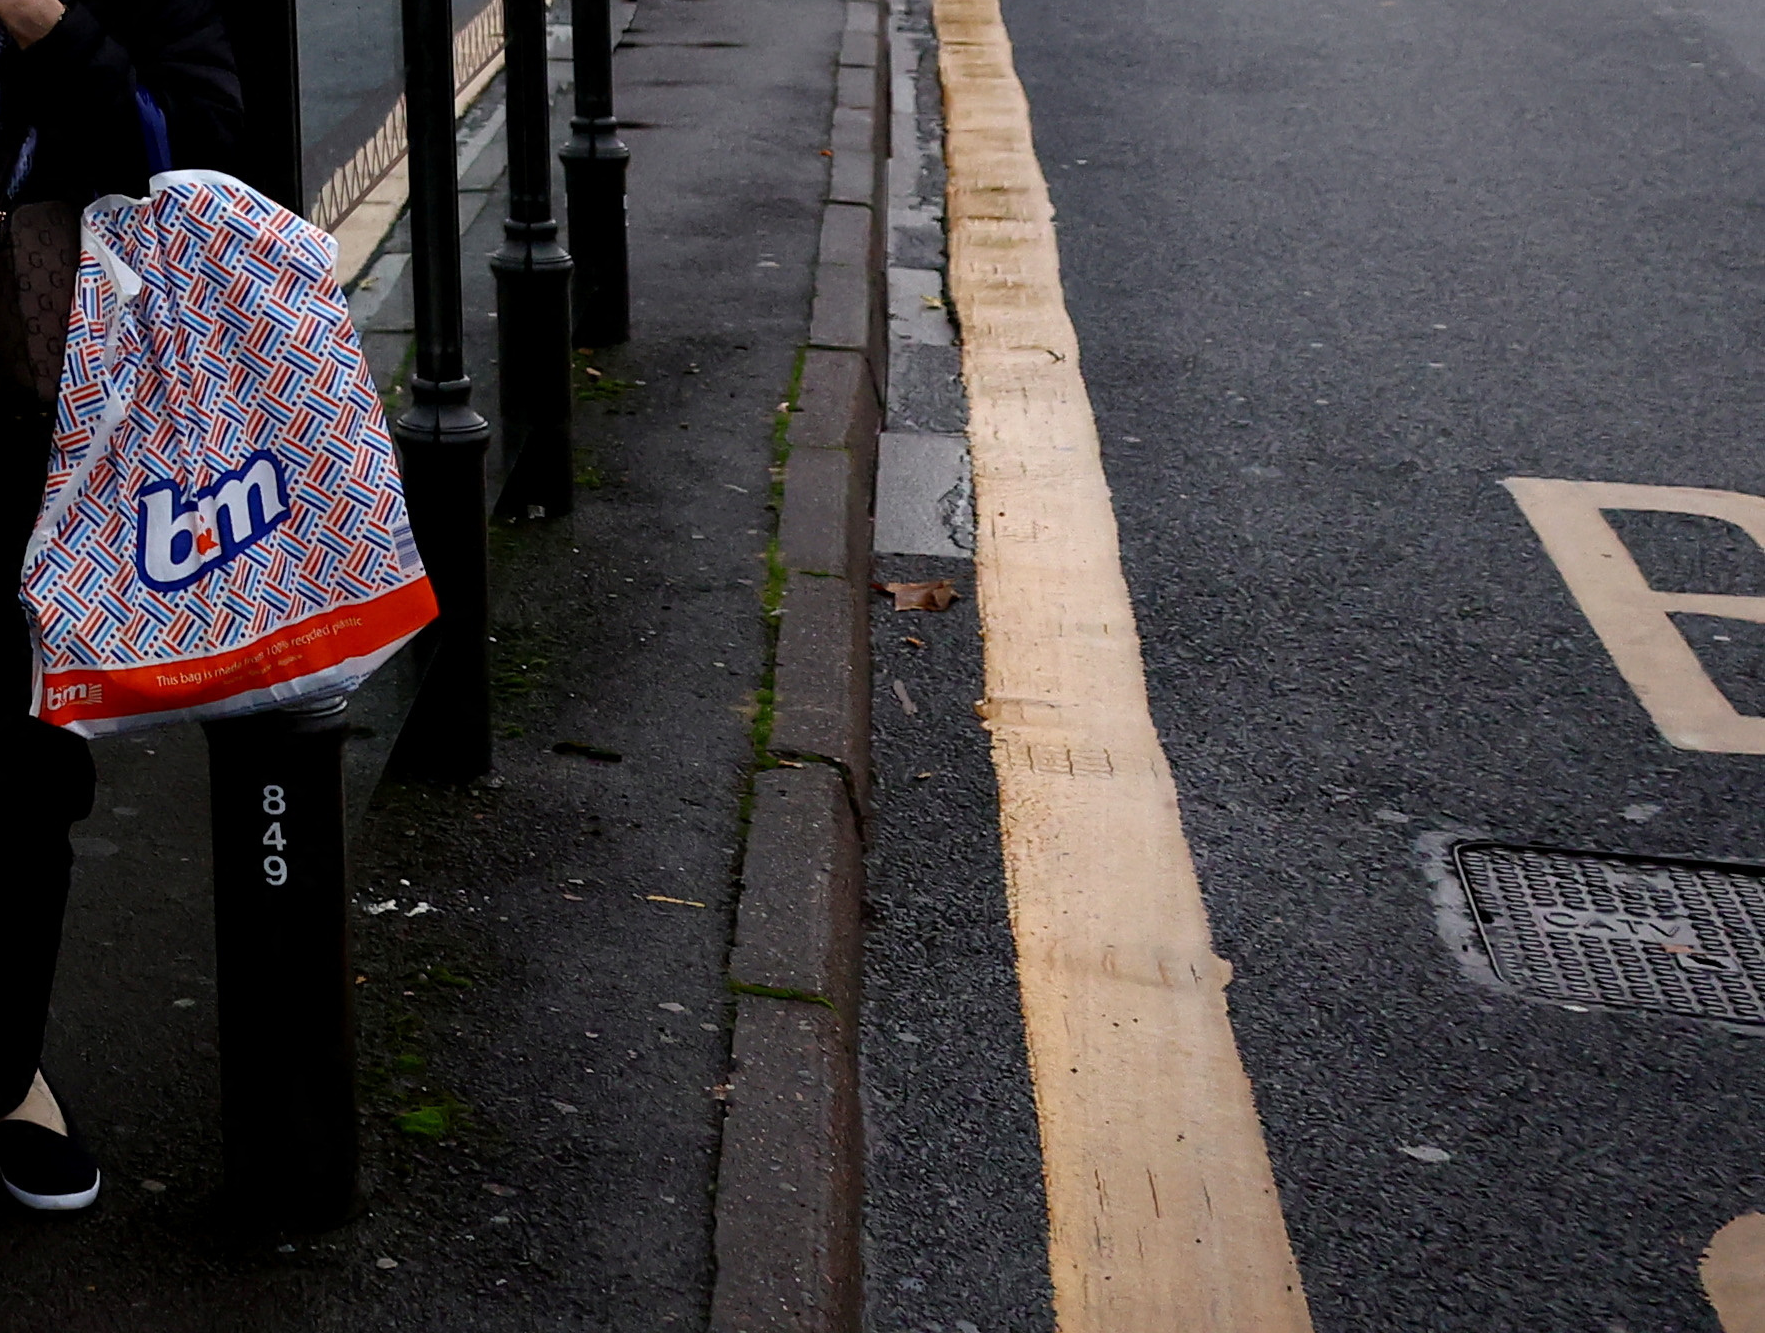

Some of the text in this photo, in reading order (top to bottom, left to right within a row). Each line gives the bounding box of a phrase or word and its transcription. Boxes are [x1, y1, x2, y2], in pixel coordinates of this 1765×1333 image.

[156, 675, 179, 687] This
[179, 670, 203, 684] bag
[203, 669, 213, 680] is
[290, 624, 330, 646] recycled
